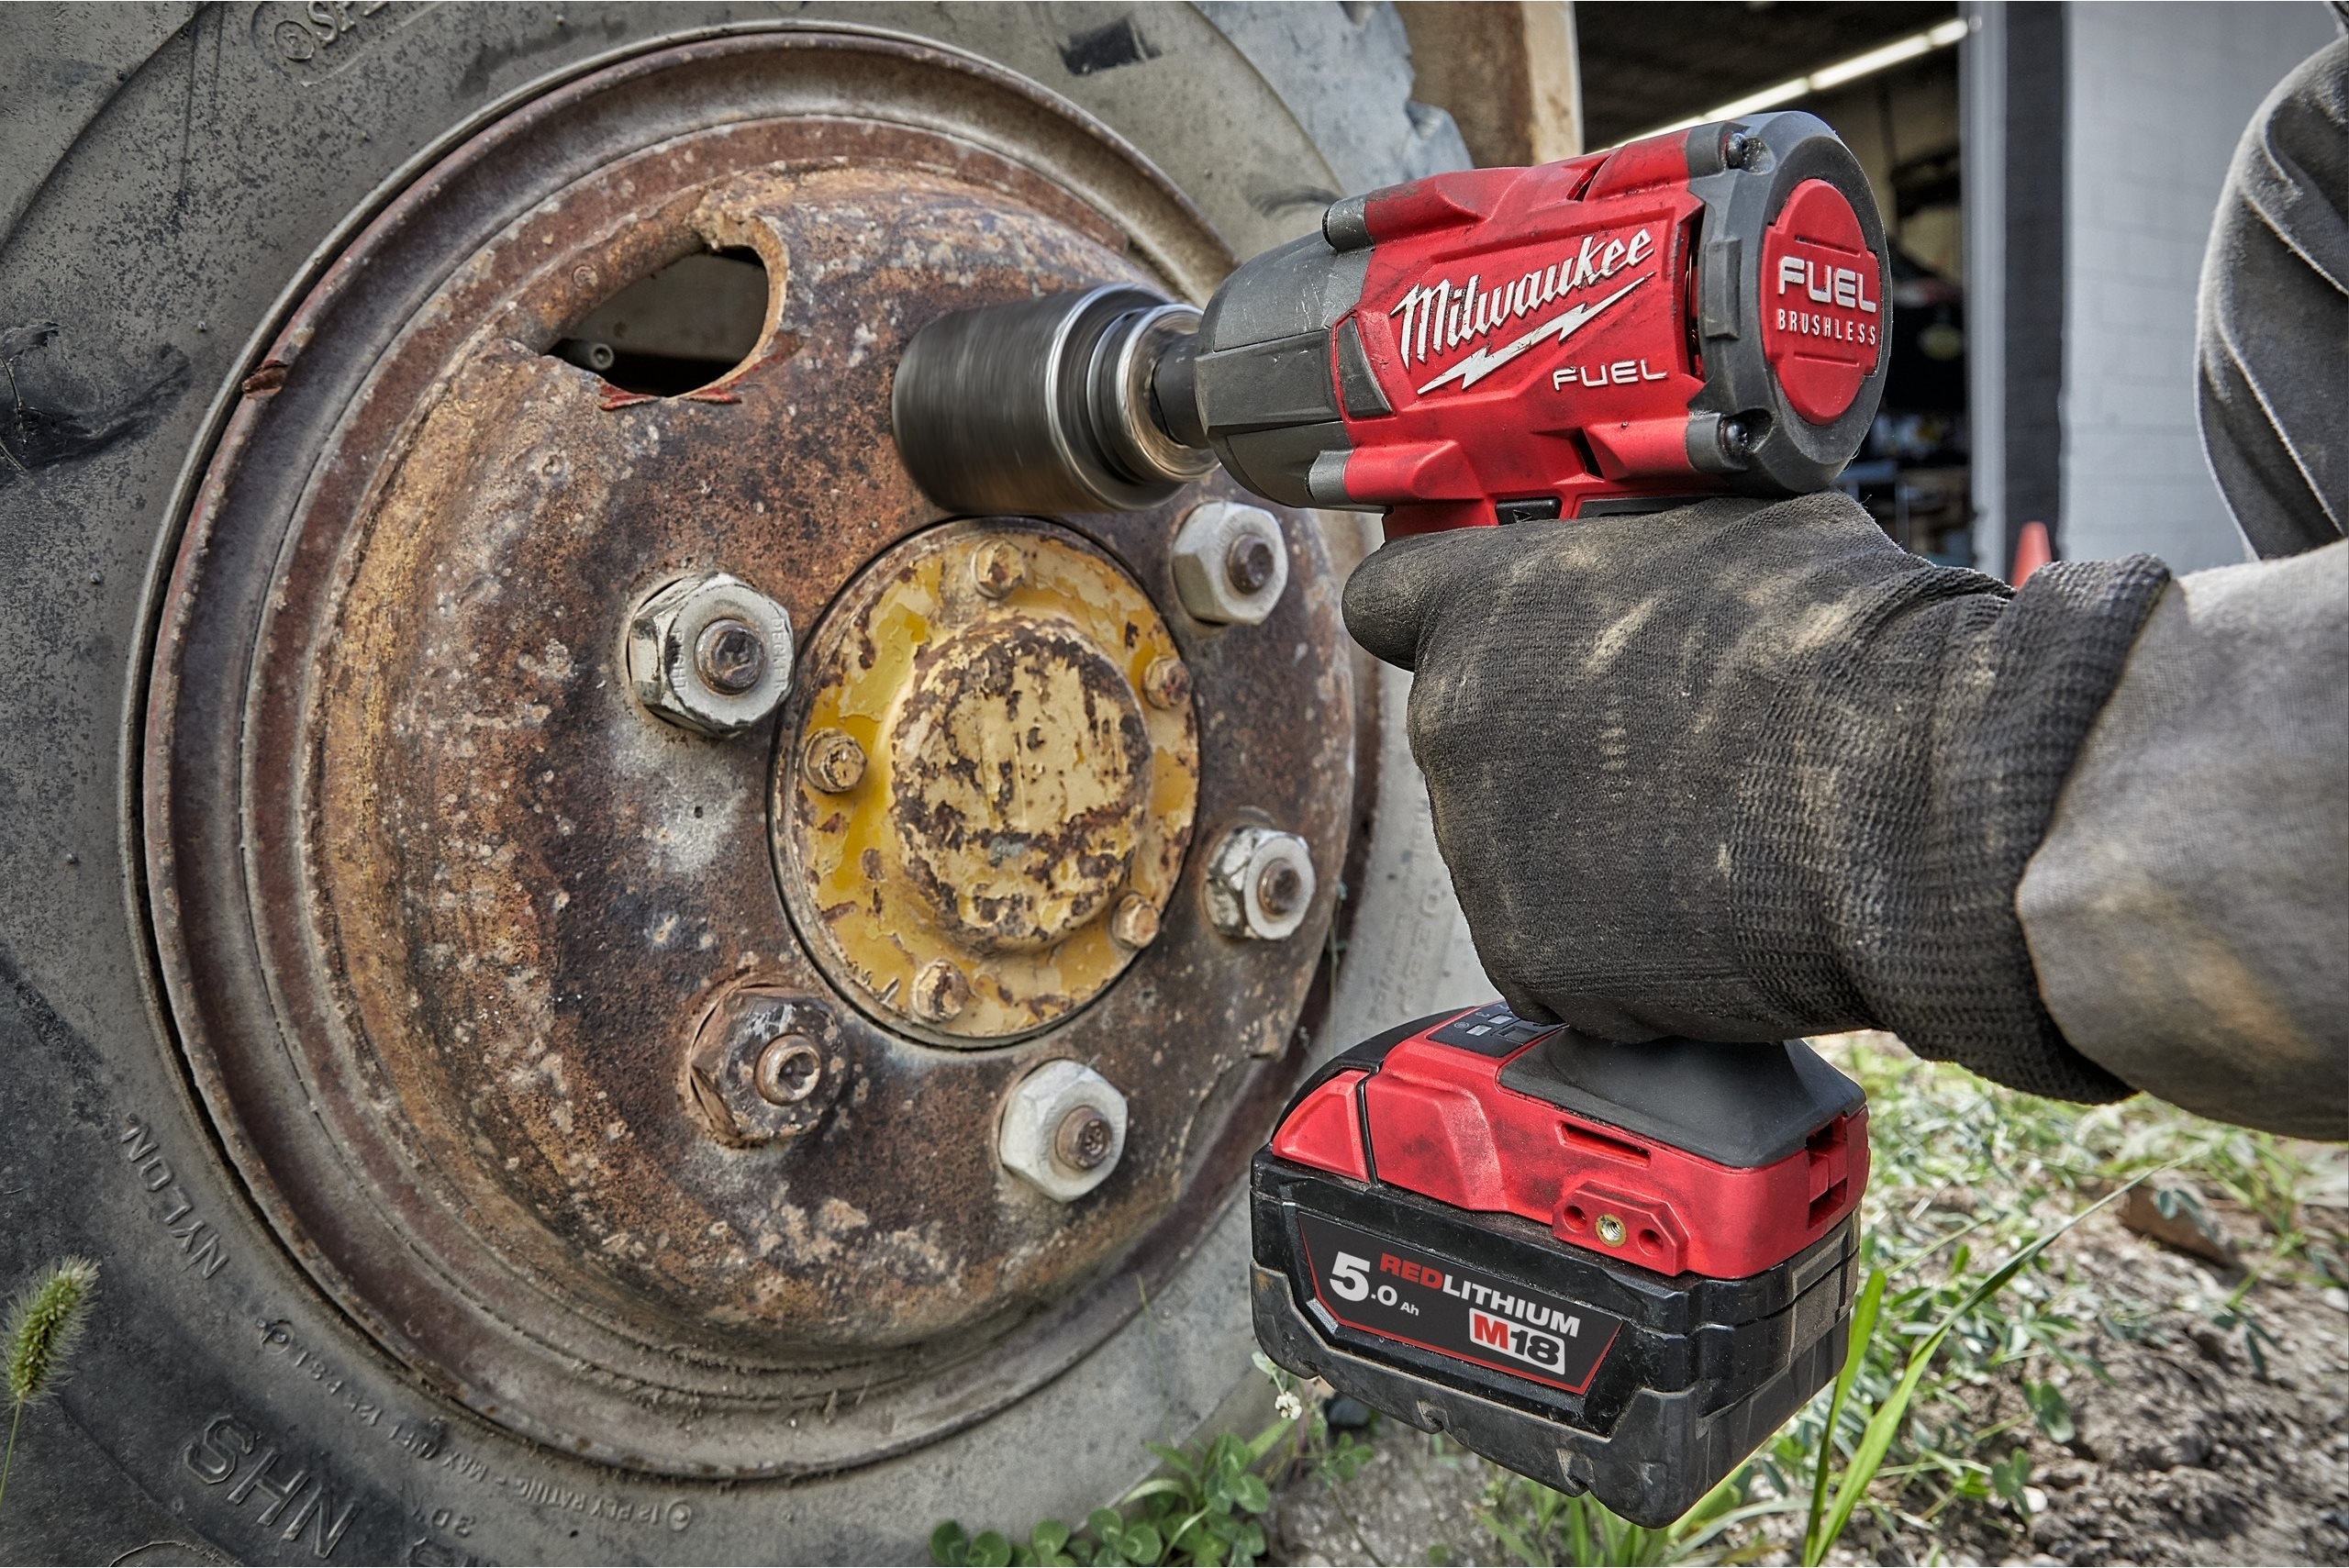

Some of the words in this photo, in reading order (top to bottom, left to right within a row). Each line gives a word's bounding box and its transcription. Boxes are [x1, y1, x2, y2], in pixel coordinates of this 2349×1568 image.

[1390, 228, 1654, 368] Milwaukee
[1777, 256, 1877, 313] FUEL
[1777, 307, 1877, 347] BRUSHLESS
[1553, 359, 1667, 391] FUEL
[1379, 1252, 1581, 1339] REDLITHIUM
[1400, 1302, 1420, 1317] Ah
[1474, 1313, 1560, 1366] M18
[184, 1415, 360, 1560] NHS
[514, 1478, 587, 1511] RATING
[590, 1497, 633, 1522] PLY
